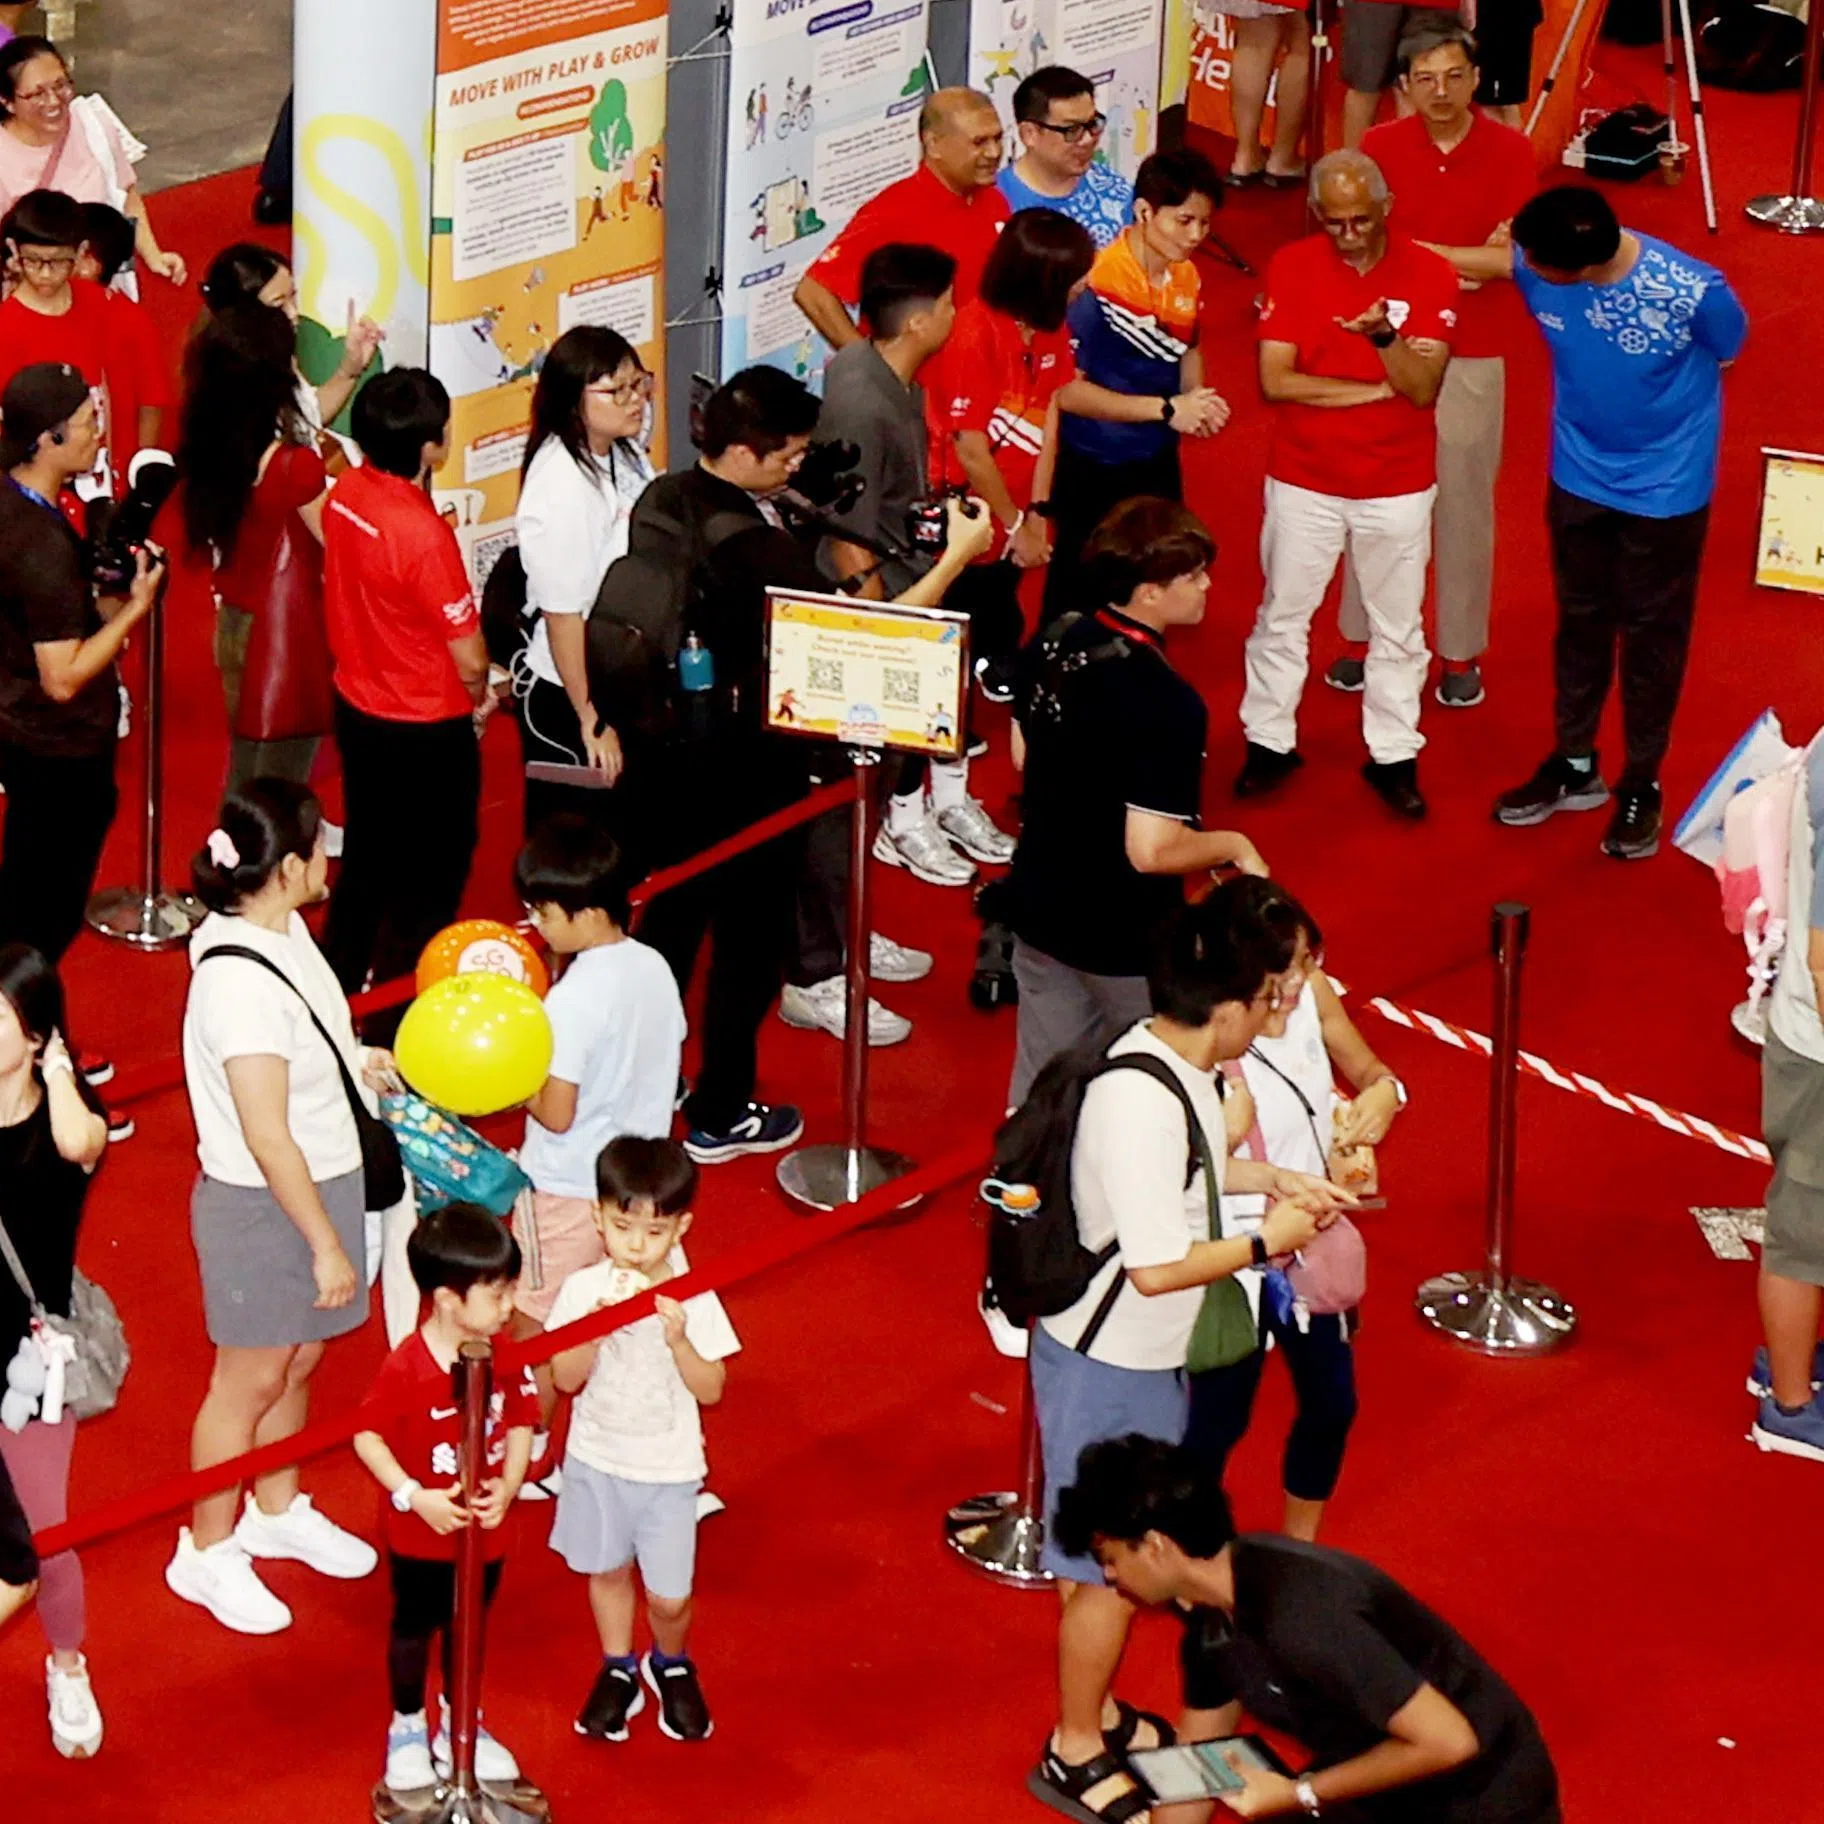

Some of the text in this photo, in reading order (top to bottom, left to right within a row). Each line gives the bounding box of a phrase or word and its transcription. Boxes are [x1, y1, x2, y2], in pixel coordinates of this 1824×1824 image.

[450, 36, 660, 108] MOVE WITH PLAY & GROW
